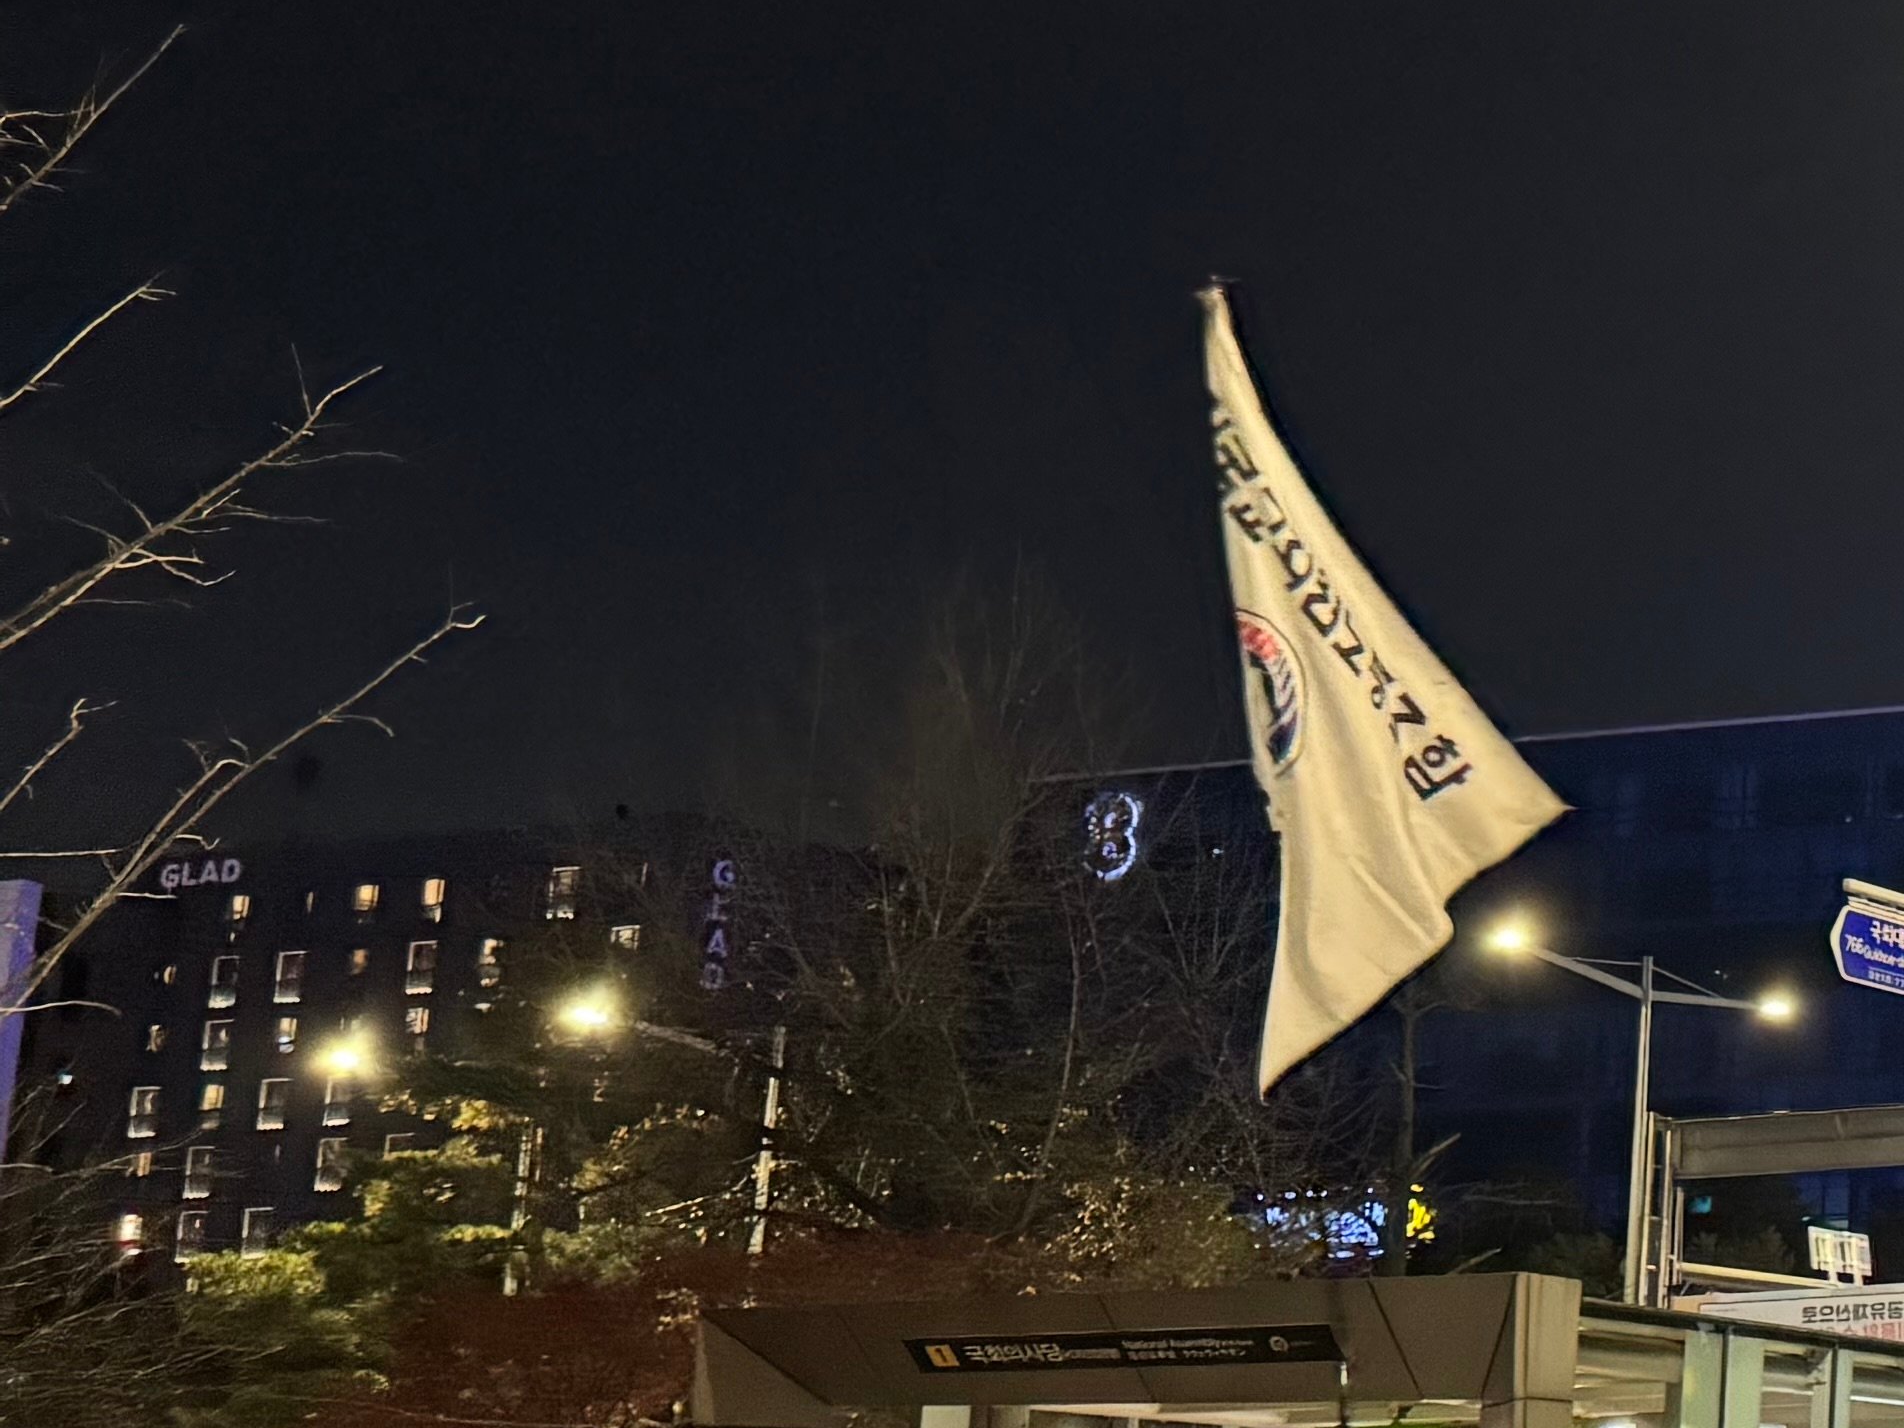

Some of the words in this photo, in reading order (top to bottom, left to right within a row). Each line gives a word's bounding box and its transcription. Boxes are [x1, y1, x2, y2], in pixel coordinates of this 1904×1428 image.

[160, 858, 241, 889] GLAD
[700, 859, 736, 989] GLAD
[933, 1347, 948, 1364] 1
